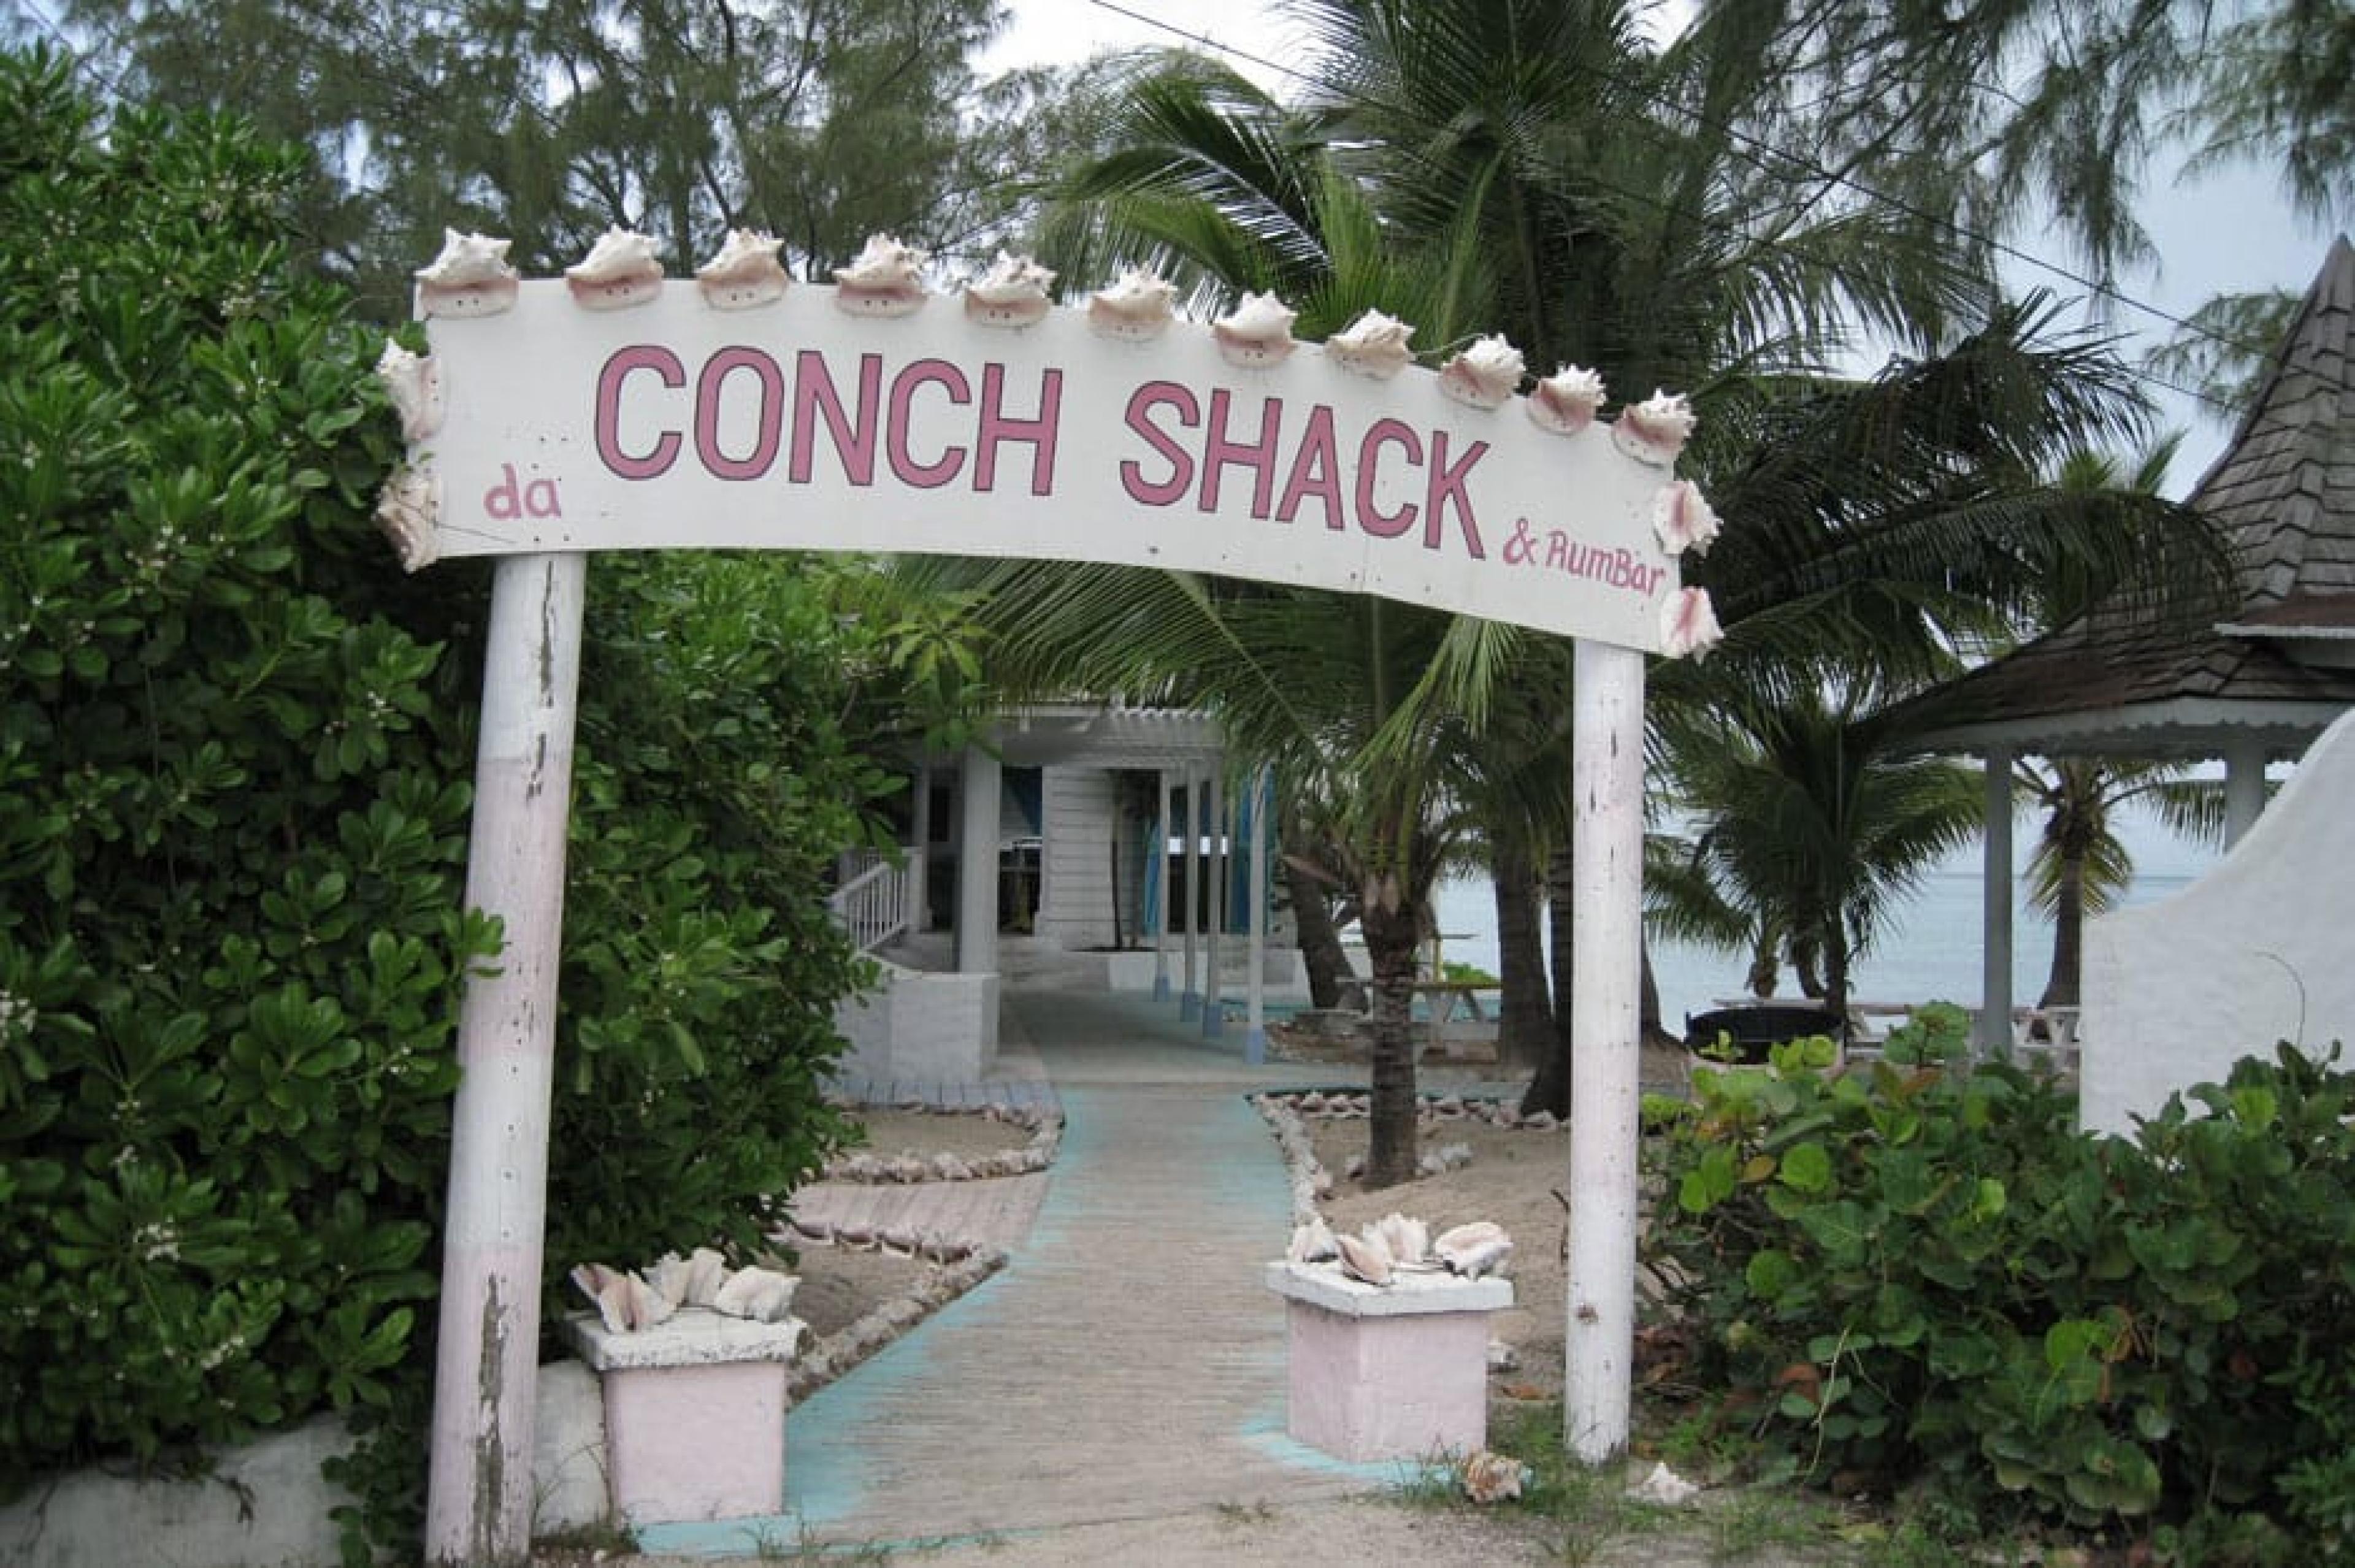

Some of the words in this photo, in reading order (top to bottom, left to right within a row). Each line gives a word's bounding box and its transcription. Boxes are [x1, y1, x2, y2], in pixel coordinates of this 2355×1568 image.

[594, 345, 1063, 495] CONCH
[1120, 380, 1491, 560] SHACK
[483, 463, 561, 520] da
[1503, 516, 1539, 566] &
